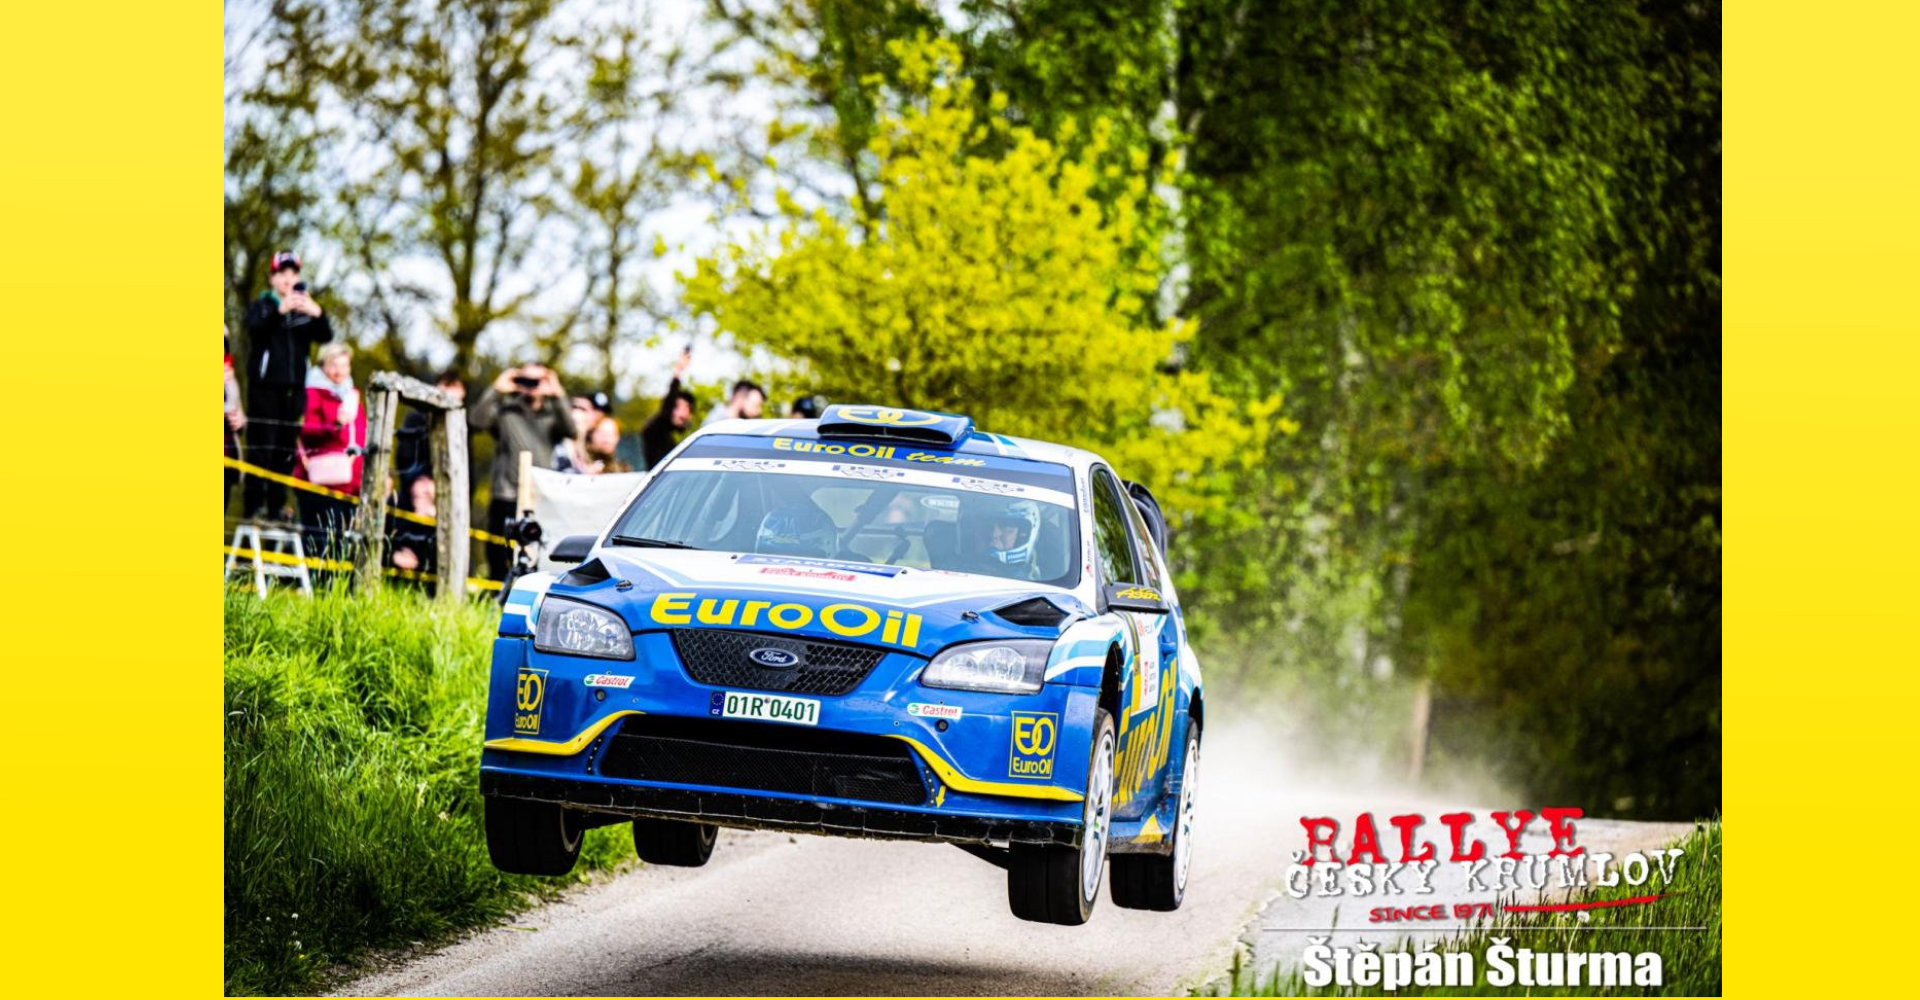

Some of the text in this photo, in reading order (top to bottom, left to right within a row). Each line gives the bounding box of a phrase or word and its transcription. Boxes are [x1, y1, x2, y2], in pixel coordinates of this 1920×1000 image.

[772, 437, 986, 466] EuroOil team
[650, 592, 923, 648] EuroOil
[761, 651, 787, 663] Ford
[596, 676, 630, 686] Castrol
[922, 705, 958, 717] Castrol
[515, 713, 539, 730] EuroOil
[1013, 757, 1053, 774] EuroOil
